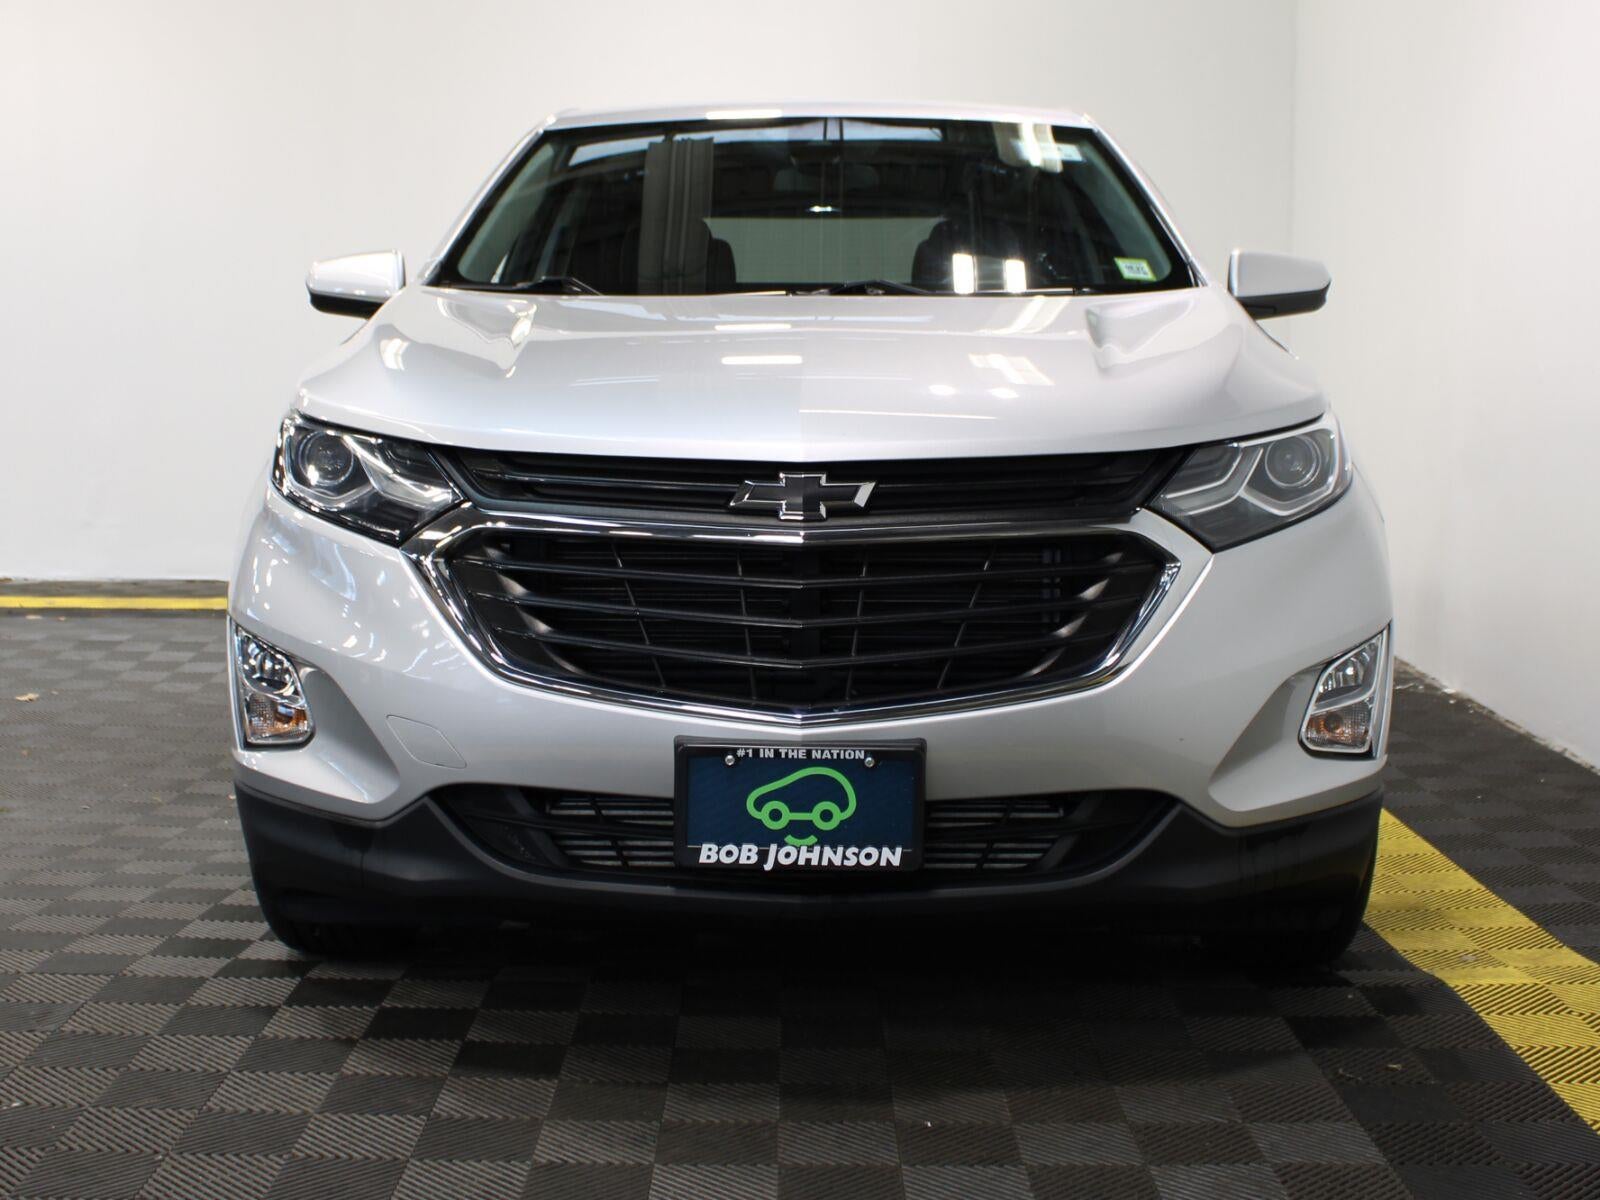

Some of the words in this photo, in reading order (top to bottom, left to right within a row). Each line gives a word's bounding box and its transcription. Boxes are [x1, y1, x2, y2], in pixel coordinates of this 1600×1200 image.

[736, 748, 753, 758] #1
[759, 748, 775, 759] IN
[779, 749, 807, 760] THE
[812, 749, 865, 760] NATION
[699, 843, 759, 865] BOB
[764, 843, 903, 871] JOHNSON
